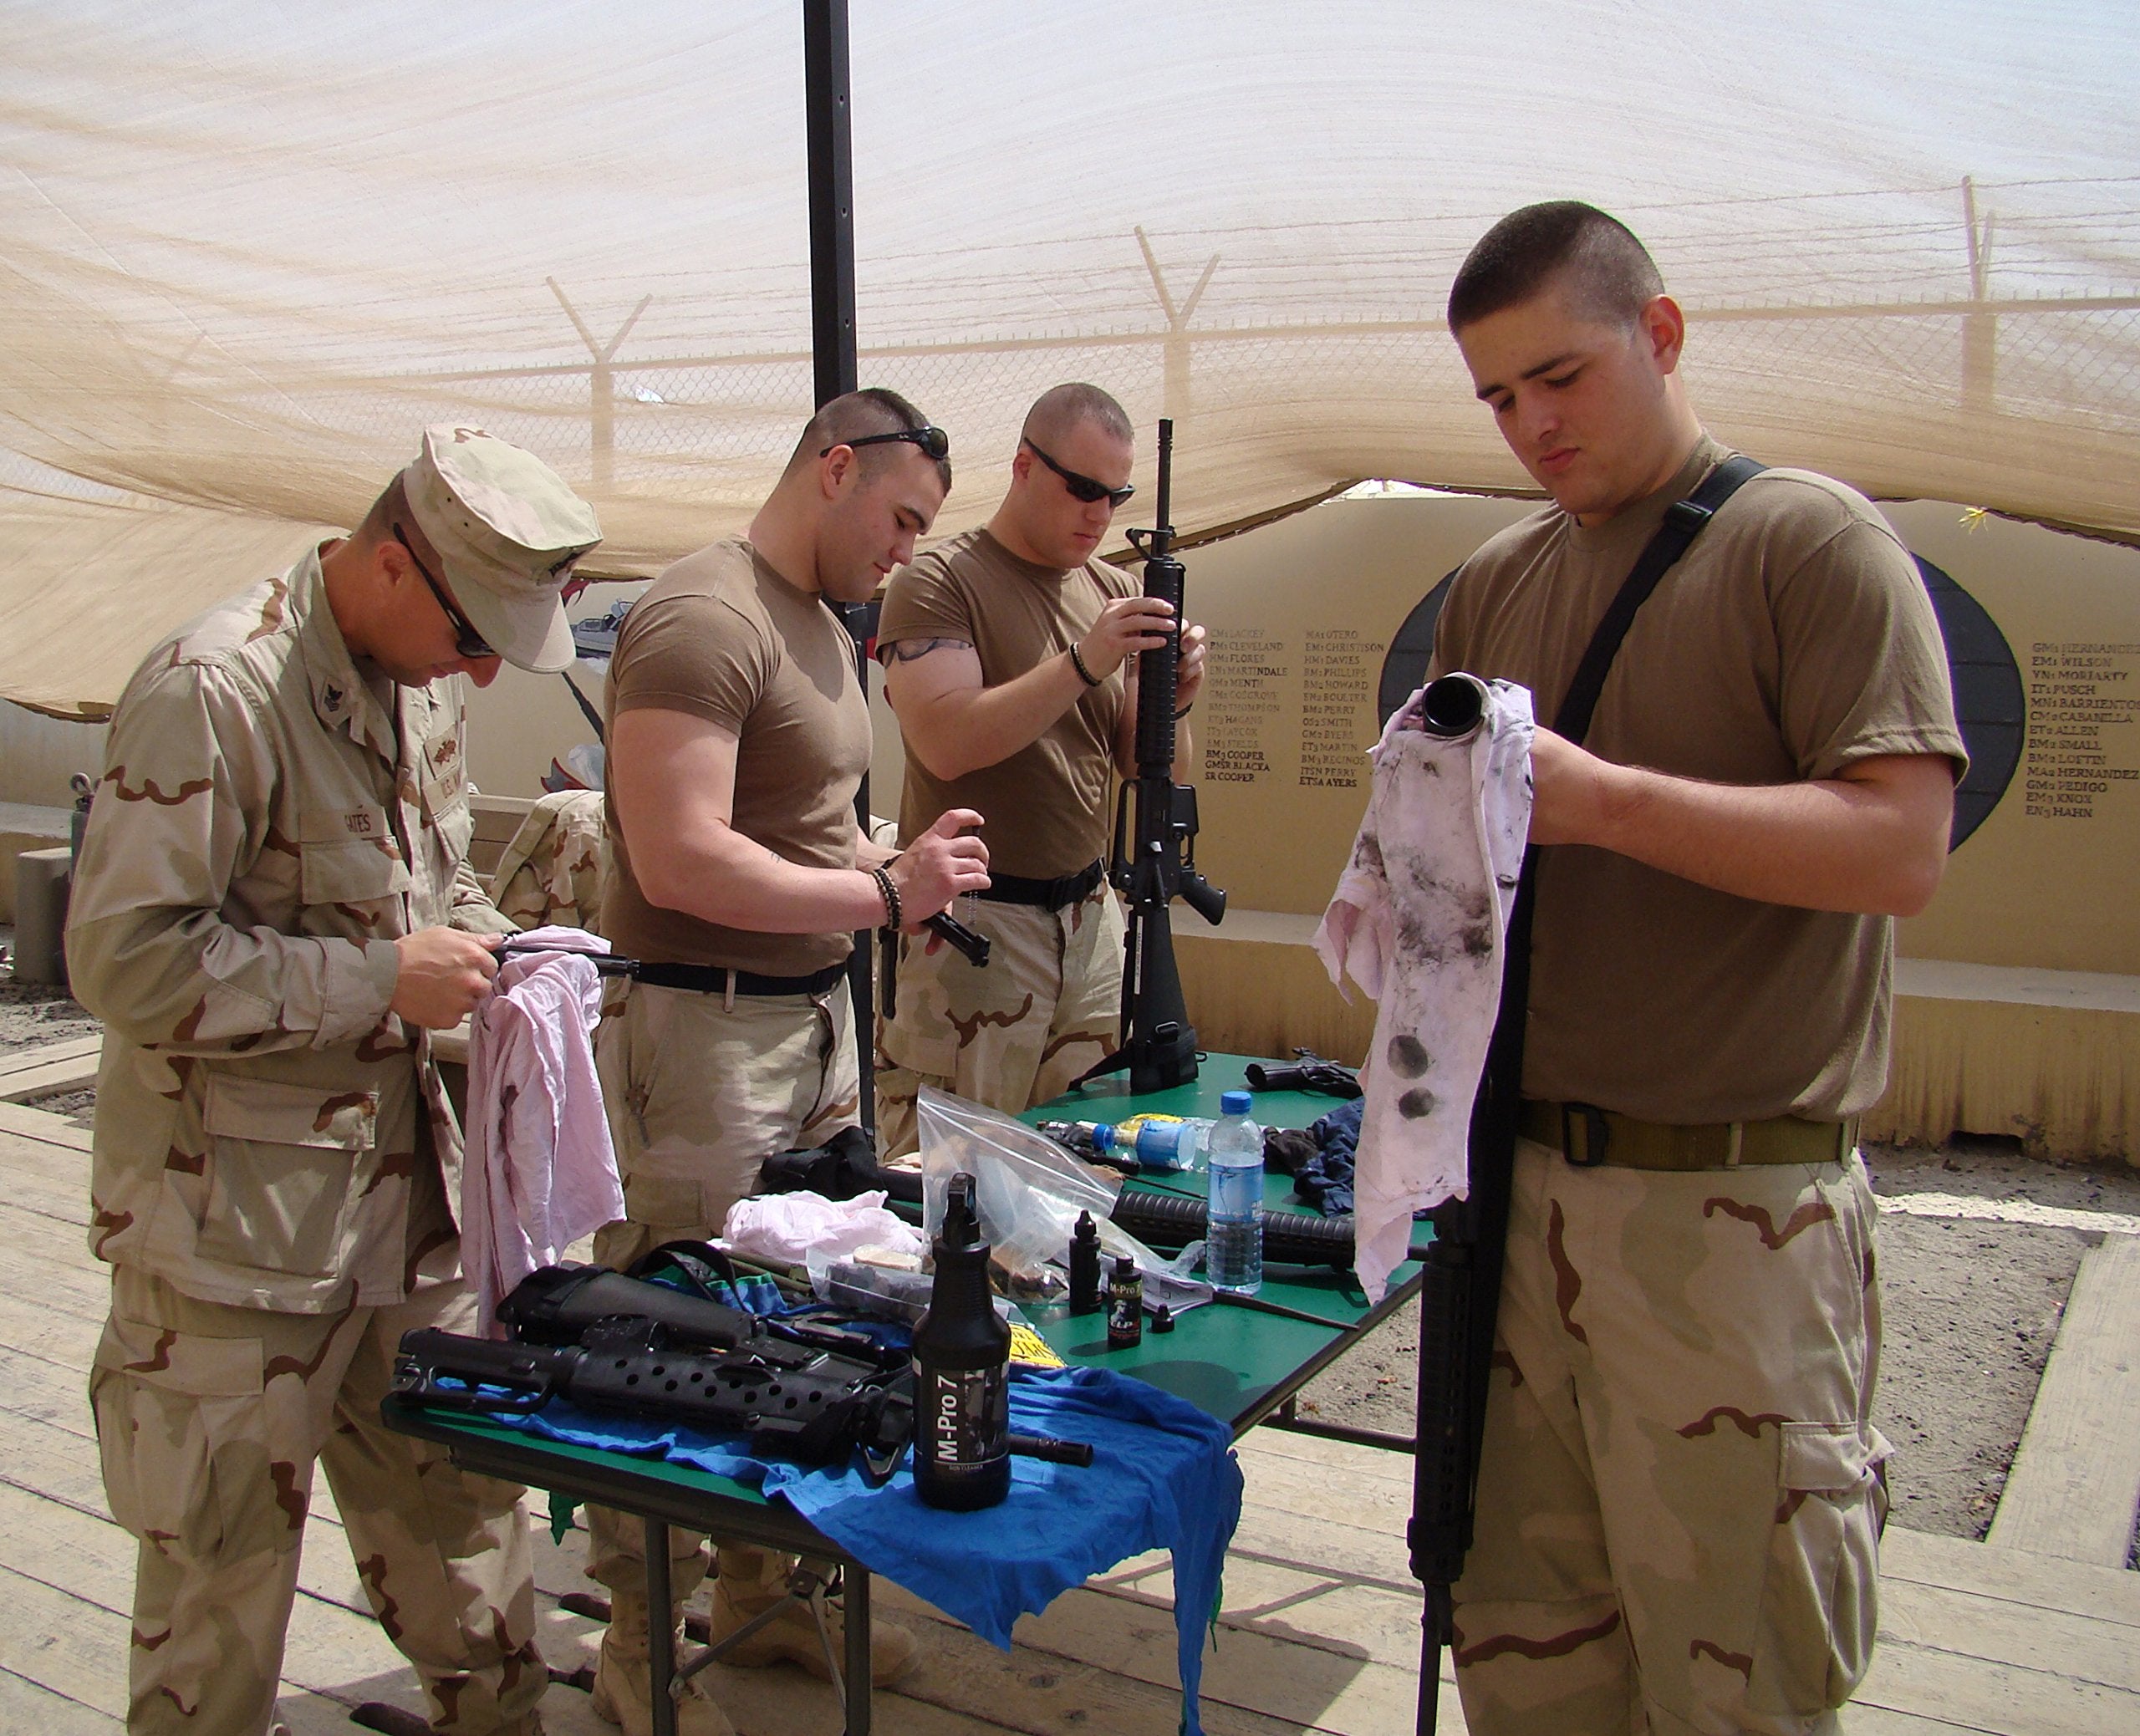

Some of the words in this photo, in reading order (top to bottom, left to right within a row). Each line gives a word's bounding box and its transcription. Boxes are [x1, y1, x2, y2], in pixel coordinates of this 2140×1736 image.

[1229, 642, 1283, 651] CLEVELAND
[1230, 654, 1265, 663] FLORES
[1326, 656, 1360, 664] DAVIES
[2061, 657, 2112, 667] WILSON
[1227, 666, 1288, 676] MARTINDALE
[1324, 668, 1367, 677] PHILLIPS
[2058, 670, 2128, 681] MORIARTY
[1324, 681, 1368, 690] HOWARD
[1323, 705, 1355, 714] PERRY
[1321, 718, 1352, 727] SMITH
[2054, 726, 2099, 736] ALLEN
[1319, 742, 1358, 751] MARTIN
[2059, 740, 2102, 751] SMALL
[1227, 751, 1264, 761] COOPER
[1325, 767, 1356, 776] PERRY
[2057, 767, 2139, 779] HERNANDEZ
[1205, 772, 1216, 781] SR
[1218, 772, 1255, 782] COOPER
[1326, 778, 1358, 787] AYERS
[2058, 781, 2107, 792] PEDIGO
[2056, 794, 2092, 804] KNOX
[2053, 807, 2092, 817] HAHN
[1109, 1282, 1136, 1296] M-Pro
[937, 1374, 958, 1388] 7
[937, 1393, 958, 1461] M-Pro
